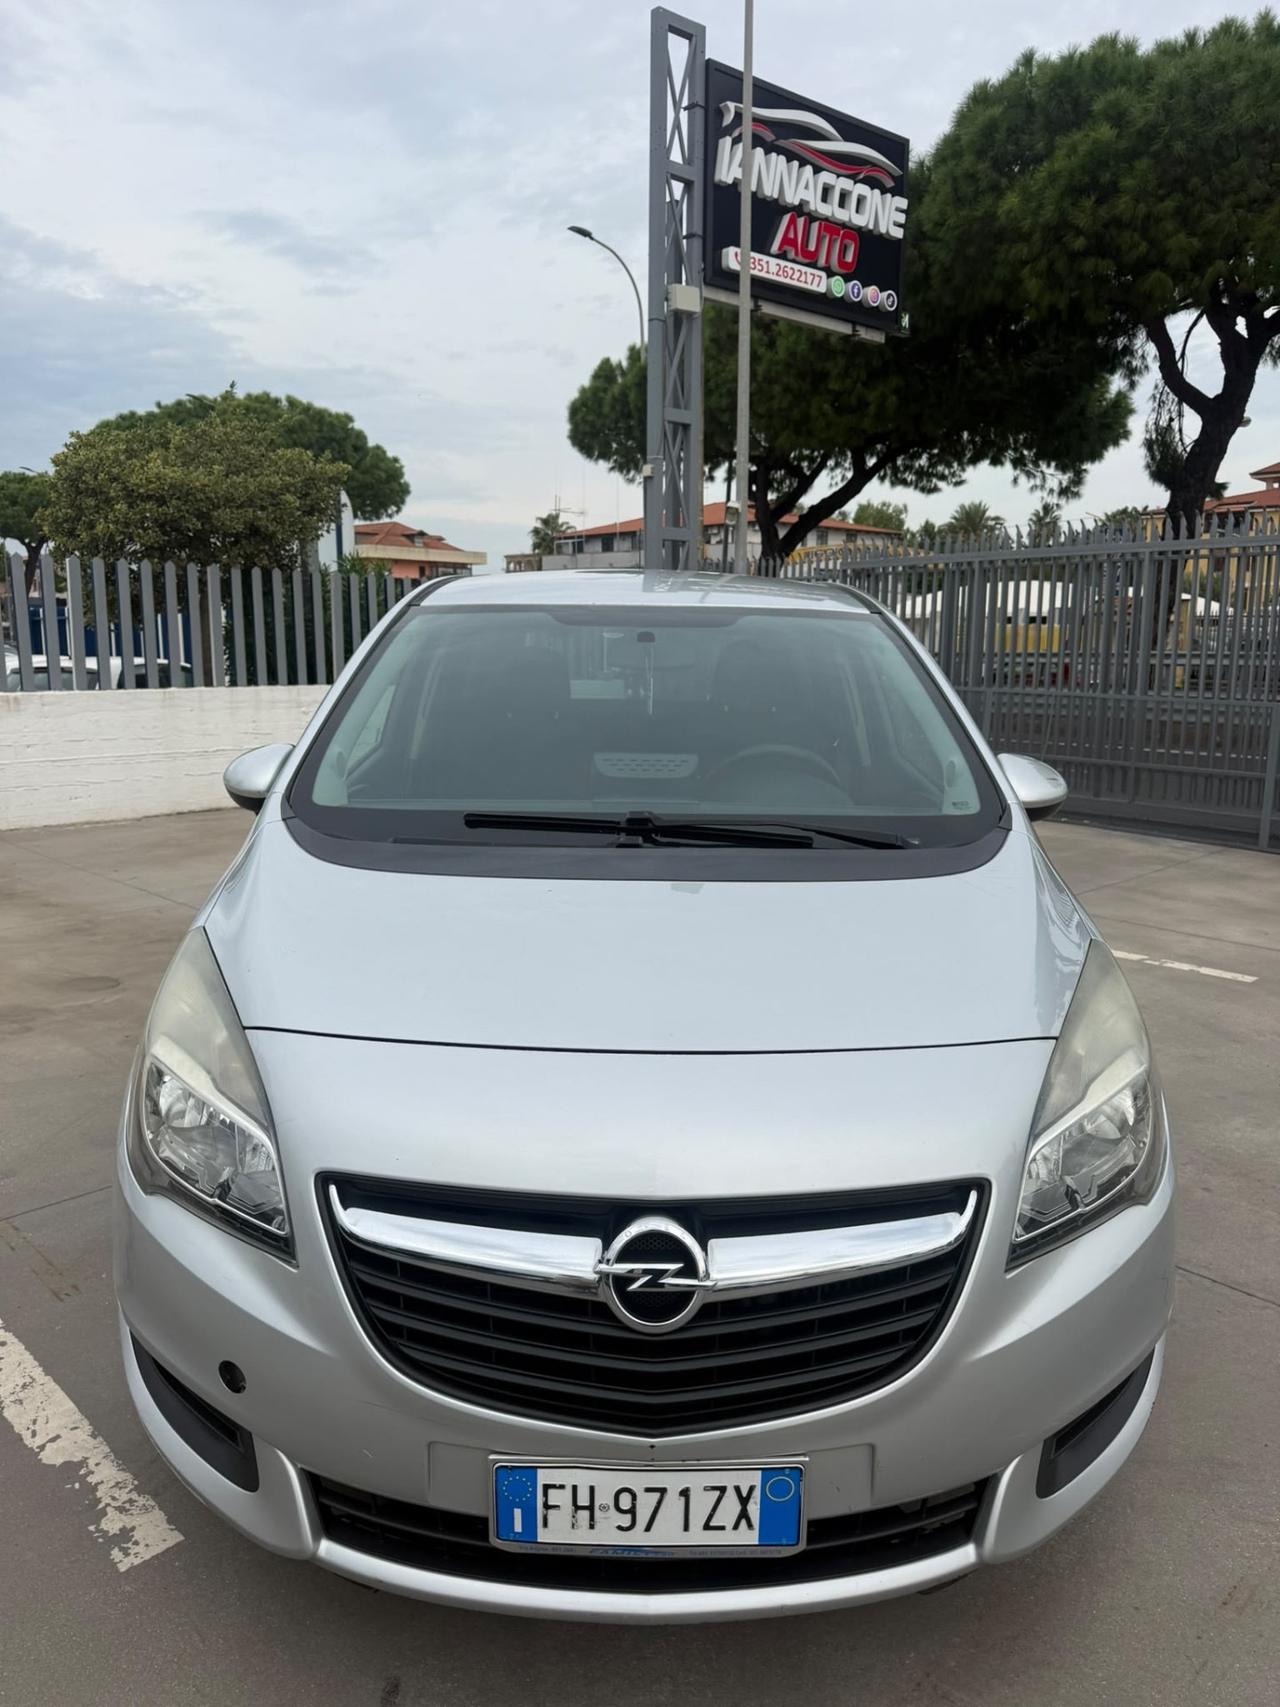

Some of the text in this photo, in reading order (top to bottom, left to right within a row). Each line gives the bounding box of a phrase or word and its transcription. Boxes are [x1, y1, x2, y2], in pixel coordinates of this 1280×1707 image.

[716, 136, 908, 239] IANNACCONE
[750, 256, 822, 288] 351.2622177
[773, 212, 860, 273] AUTO
